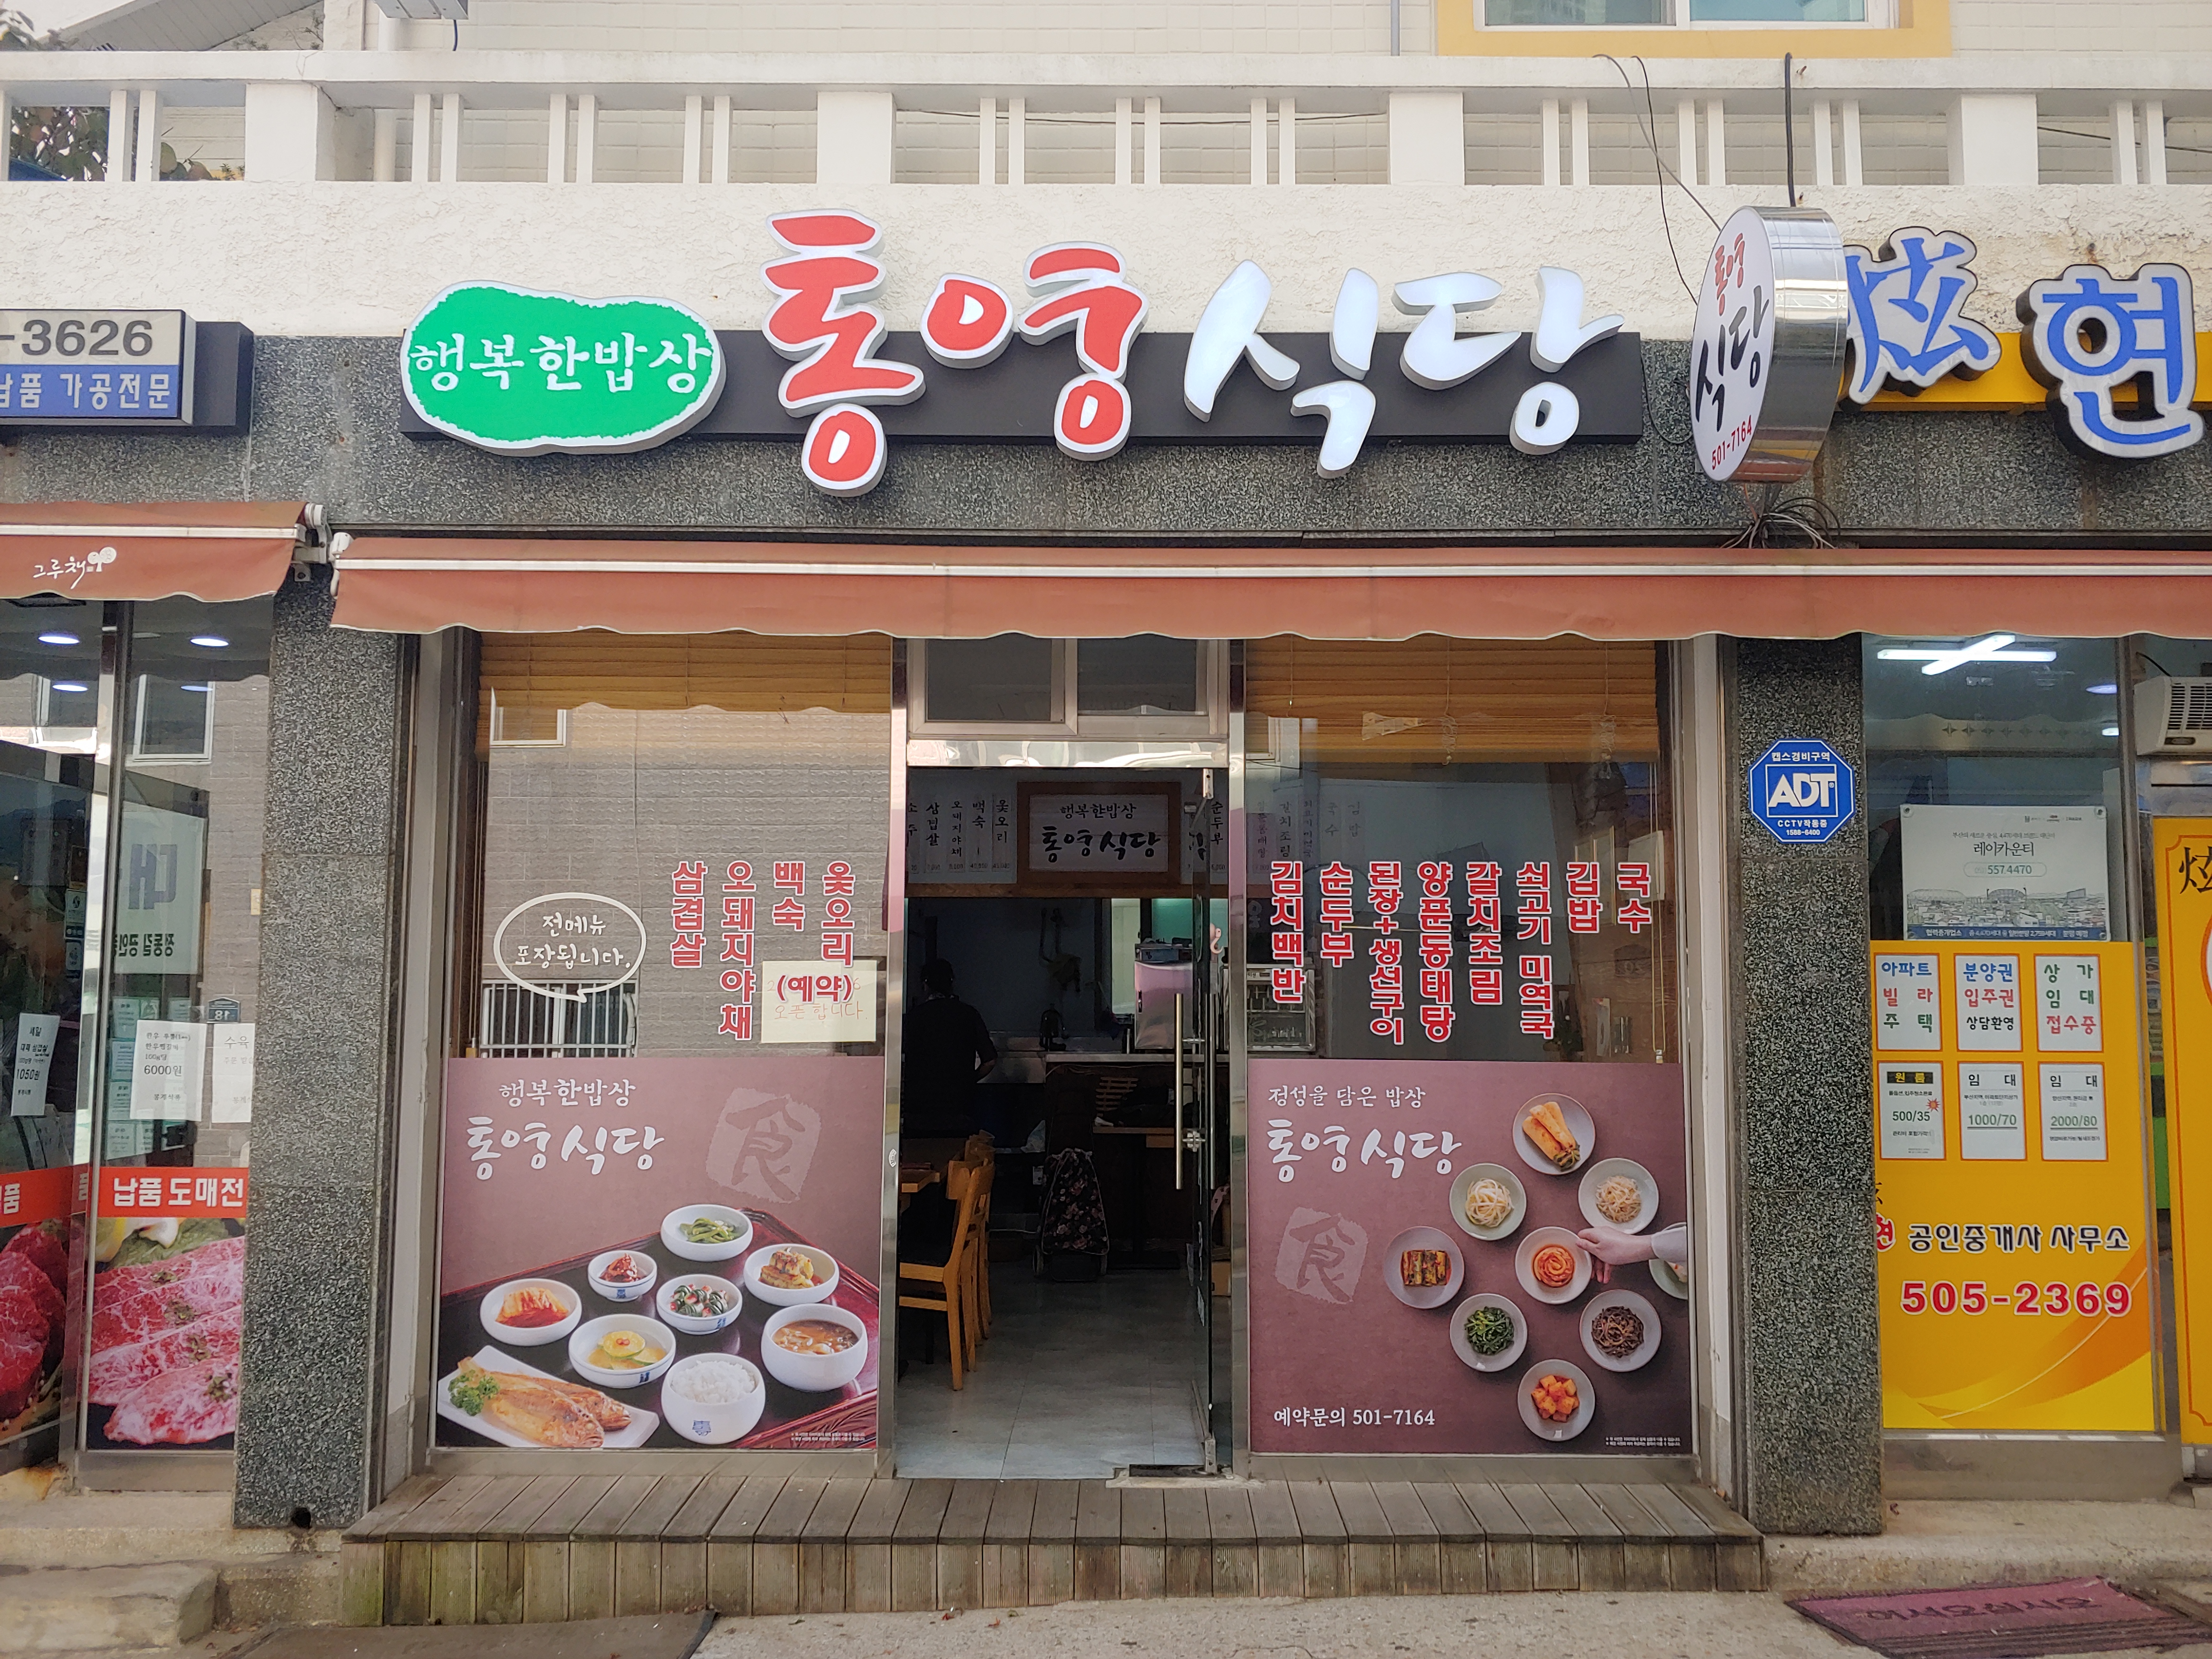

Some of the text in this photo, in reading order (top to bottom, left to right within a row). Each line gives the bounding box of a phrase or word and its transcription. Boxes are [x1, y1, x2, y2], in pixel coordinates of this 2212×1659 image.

[761, 209, 1625, 496] 통영 식당
[1695, 285, 1770, 431] 식당
[2033, 264, 2204, 458] 현
[60, 373, 170, 410] 가공전문
[1712, 415, 1753, 471] 501-7164
[1772, 752, 1830, 761] 캡스경비구역
[1768, 773, 1837, 807] ADT
[1099, 831, 1161, 860] 식당
[1974, 841, 2034, 857] 레이카운티
[772, 861, 806, 932] 백숙
[1566, 861, 1603, 934] 김밥
[1617, 862, 1652, 934] 국수
[542, 912, 606, 937] 전메뉴
[670, 861, 708, 969] 삼겹살
[1320, 861, 1354, 968] 순두부
[1271, 861, 1306, 1003] 김치백반
[1466, 861, 1502, 1006] 갈치조림
[515, 943, 631, 970] 포장됩니다.
[1417, 861, 1456, 1043] 양푼동태탕
[1881, 962, 1932, 977] 아파트
[1963, 963, 2013, 982] 분양권
[776, 974, 854, 1004] (예약)
[1964, 989, 2014, 1008] 입주권
[1966, 1016, 2014, 1031] 상담환영
[2046, 1015, 2097, 1035] 접수중
[224, 1036, 249, 1049] 수육
[144, 1065, 182, 1077] 6000원
[1268, 1085, 1426, 1108] 정성을 담은 밥상
[1892, 1110, 1931, 1122] 500/35
[1968, 1113, 2017, 1126] 1000/70
[2050, 1115, 2098, 1127] 2000/80
[561, 1124, 665, 1175] 식당
[1361, 1127, 1462, 1179] 식당
[113, 1177, 162, 1207] 납품
[167, 1178, 244, 1208] 도매전
[1908, 1223, 2042, 1253] 공인중개사
[2049, 1224, 2131, 1254] 사무소
[1900, 1280, 2132, 1317] 505-2369
[1273, 1407, 1436, 1428] 예약문의 501-7164
